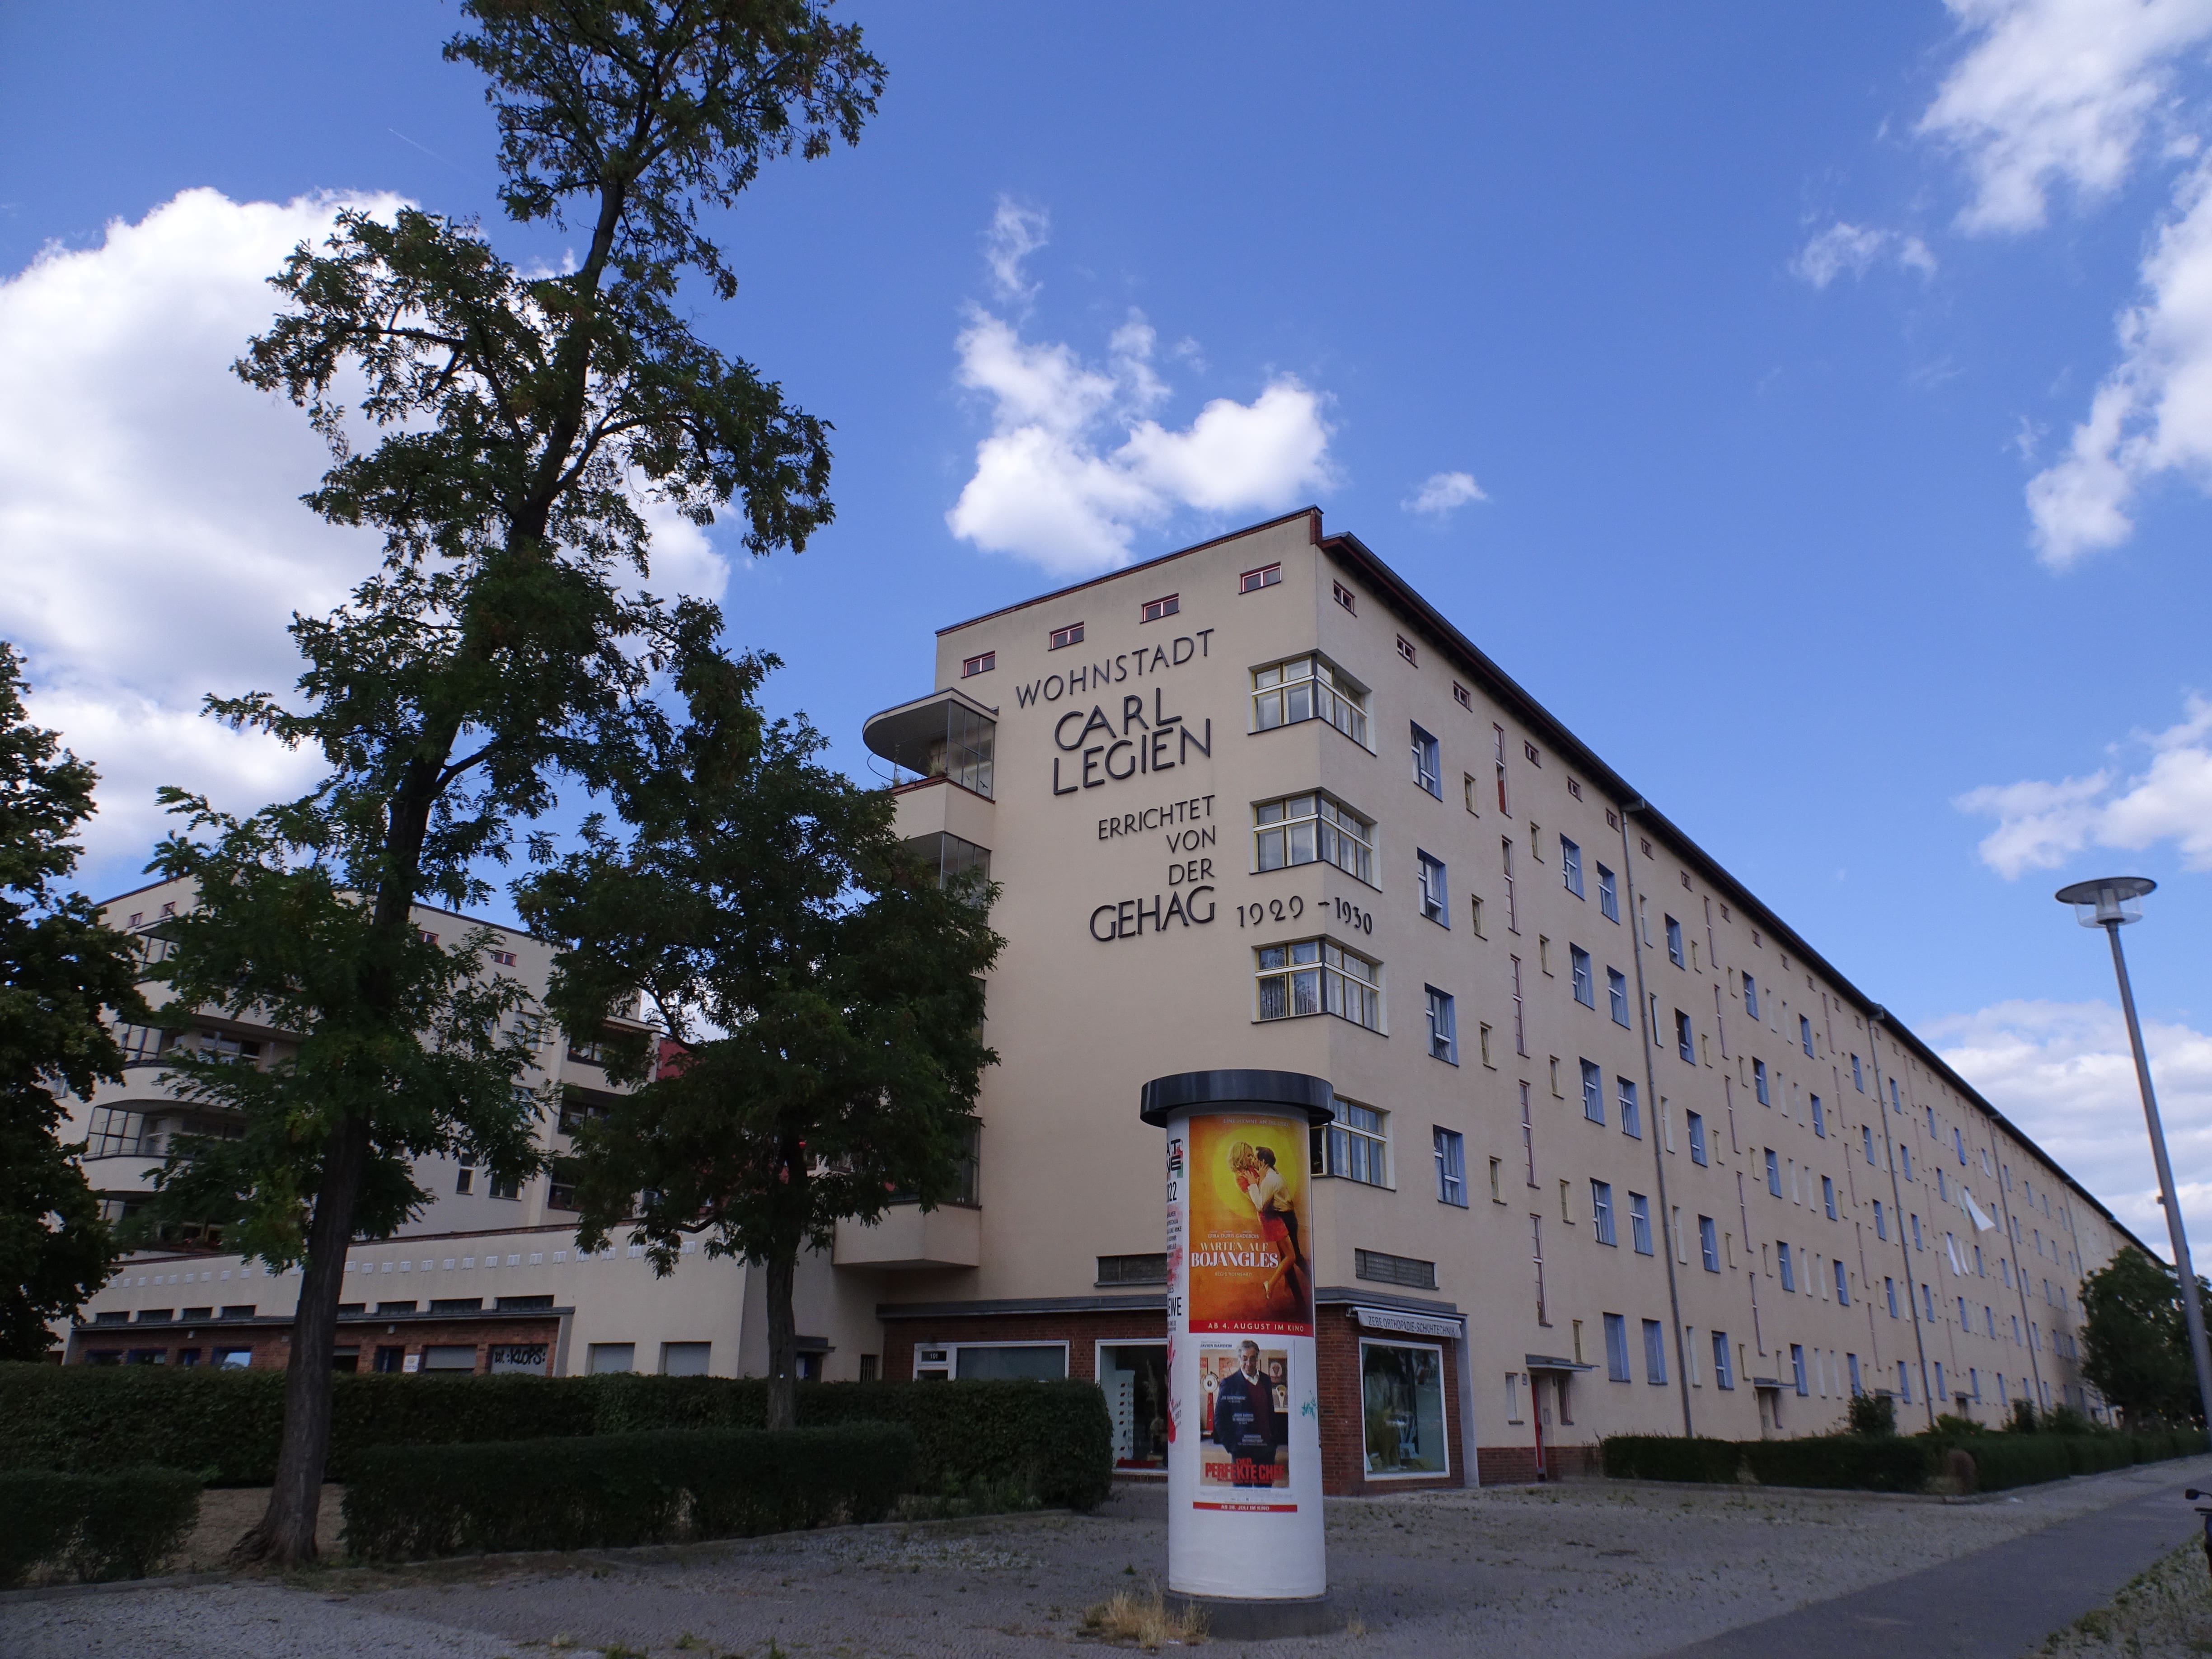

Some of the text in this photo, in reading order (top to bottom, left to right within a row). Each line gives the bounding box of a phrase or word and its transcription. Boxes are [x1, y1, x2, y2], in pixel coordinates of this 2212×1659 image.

[1016, 628, 1214, 709] WOHNSTADT
[1054, 687, 1182, 750] CARL
[1053, 717, 1211, 795] LEGIEN
[1098, 794, 1215, 839] ERRICHTET
[1166, 825, 1216, 853] VON
[1168, 858, 1215, 886] DER
[1089, 886, 1215, 942] GEHAG
[1237, 895, 1304, 928] 1929
[1191, 1251, 1279, 1268] BOJANGLES
[1200, 1242, 1269, 1251] WARTEN AUF
[1167, 1296, 1182, 1317] EWE
[1287, 1324, 1304, 1332] KINO
[1368, 1316, 1382, 1327] ZEBE
[1205, 1462, 1284, 1481] PERFEKTE CHEF
